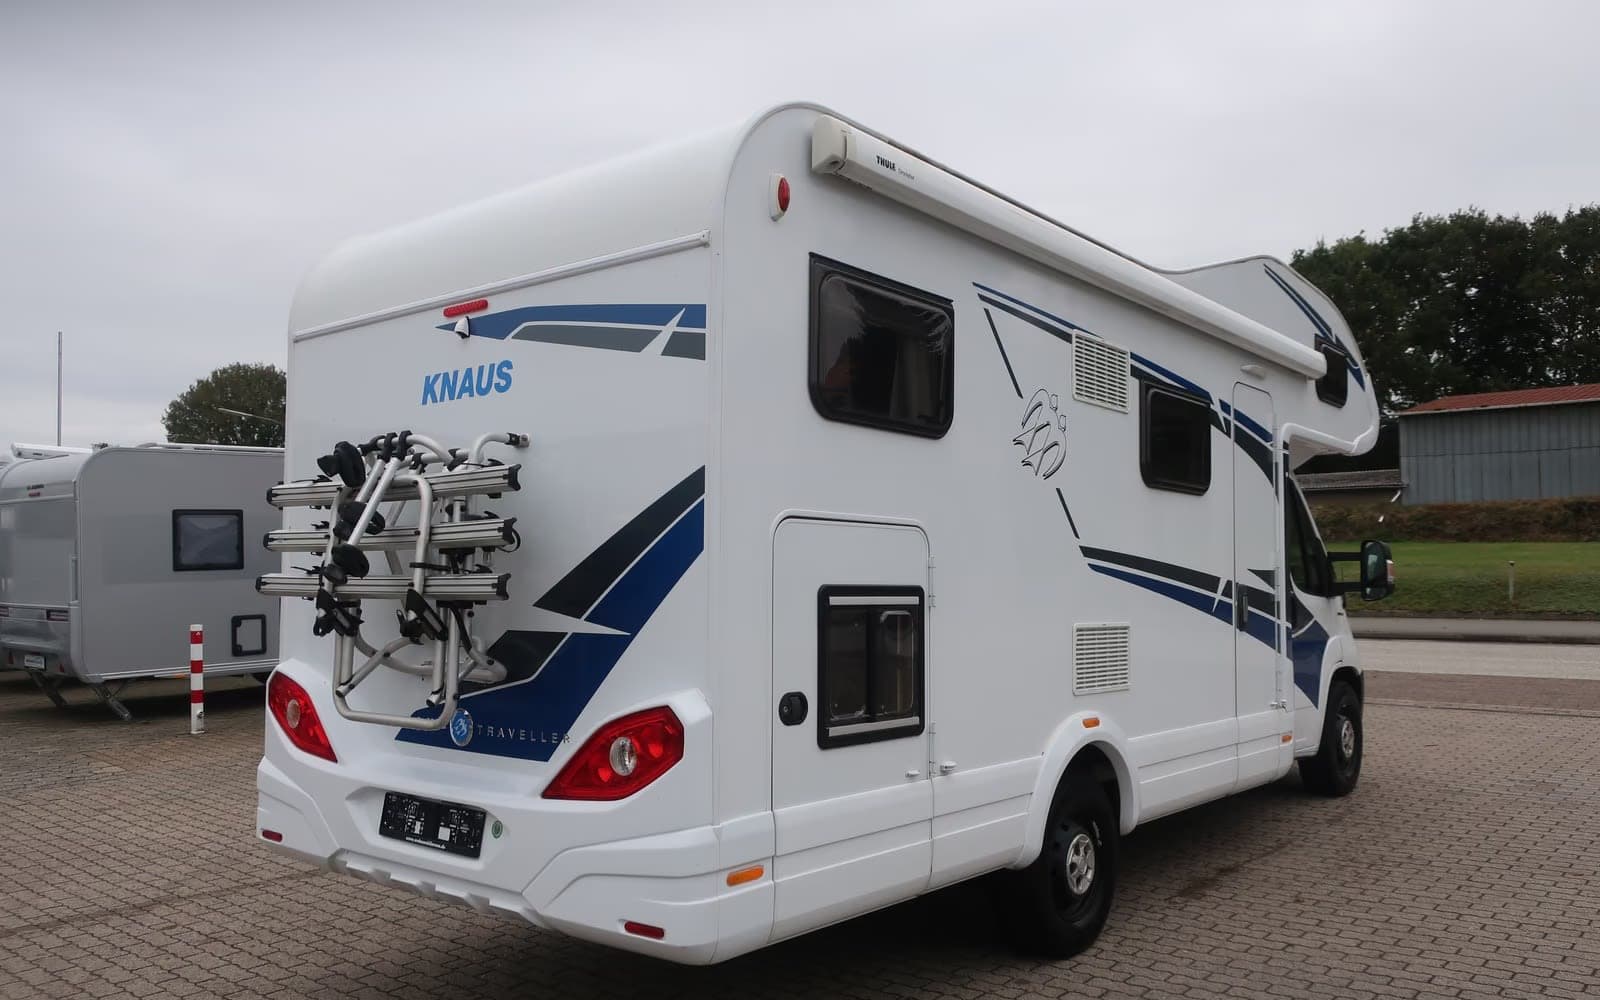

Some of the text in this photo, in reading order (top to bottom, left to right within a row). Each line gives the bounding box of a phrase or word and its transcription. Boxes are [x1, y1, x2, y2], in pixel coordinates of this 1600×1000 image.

[876, 155, 896, 171] THULE
[421, 360, 513, 405] KNAUS
[477, 715, 571, 744] TRAVELLER
